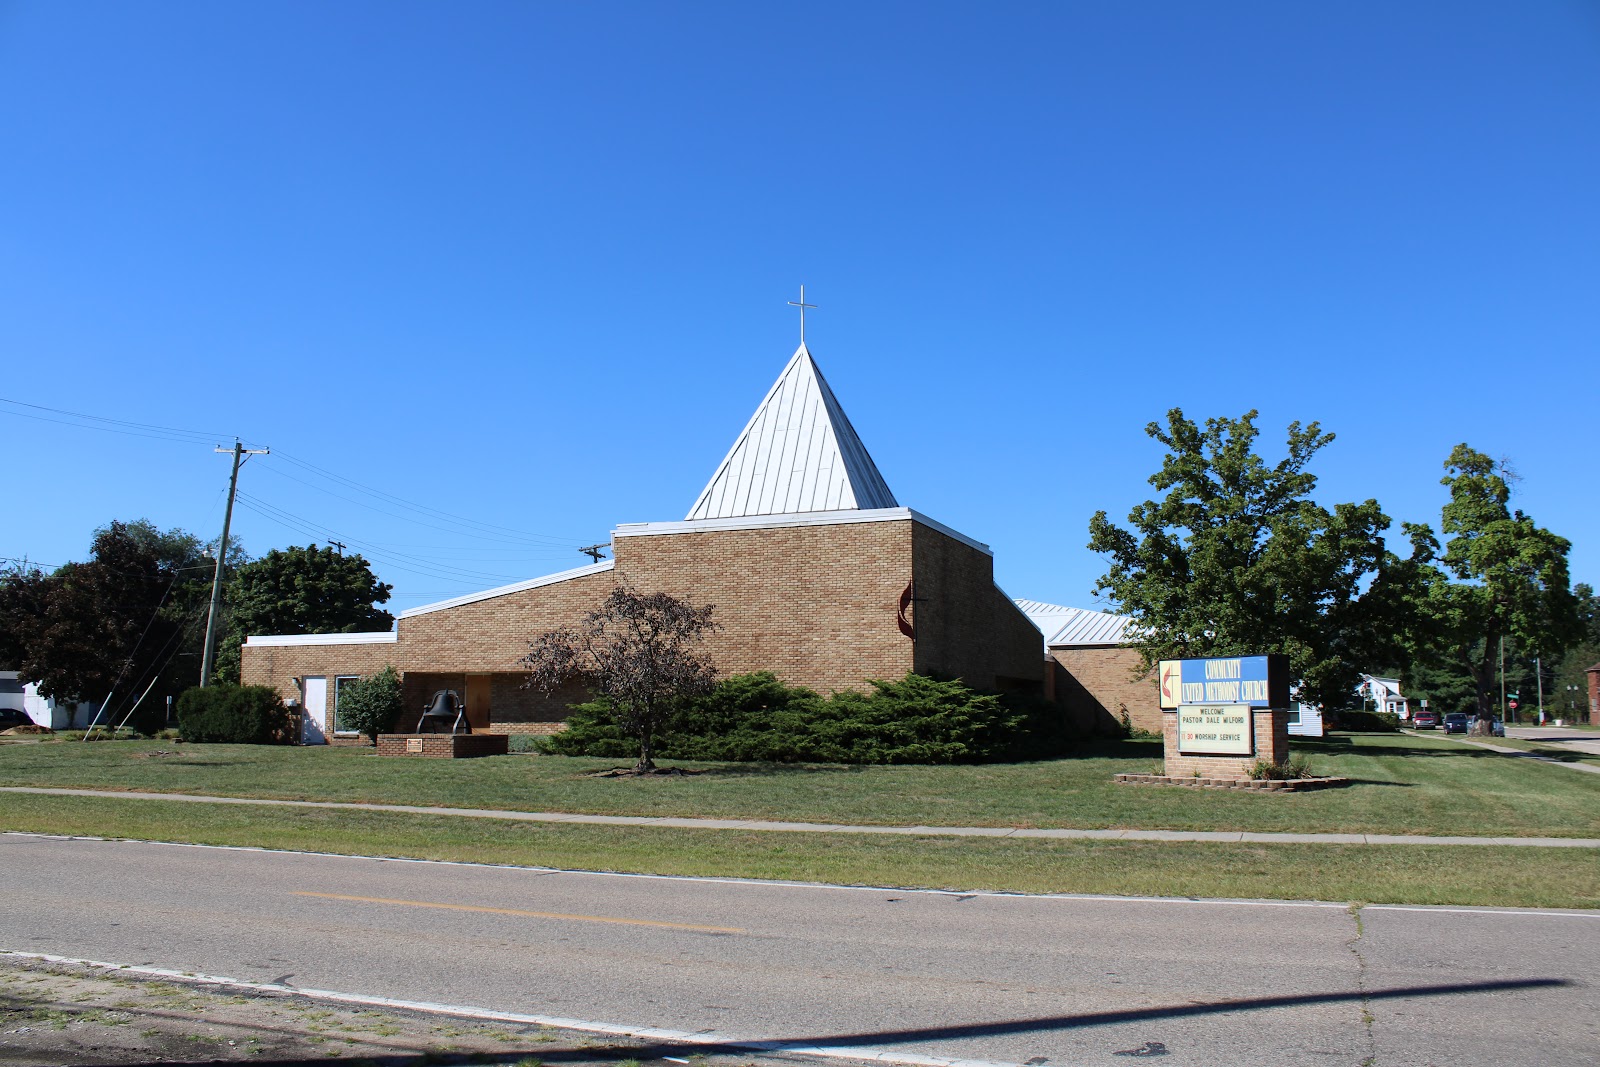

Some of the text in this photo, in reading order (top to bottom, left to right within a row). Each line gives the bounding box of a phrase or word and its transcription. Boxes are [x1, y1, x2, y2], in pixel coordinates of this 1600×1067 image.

[1205, 659, 1241, 679] COMMUNITY
[1182, 680, 1268, 701] UNITED METHODIST CHURCH
